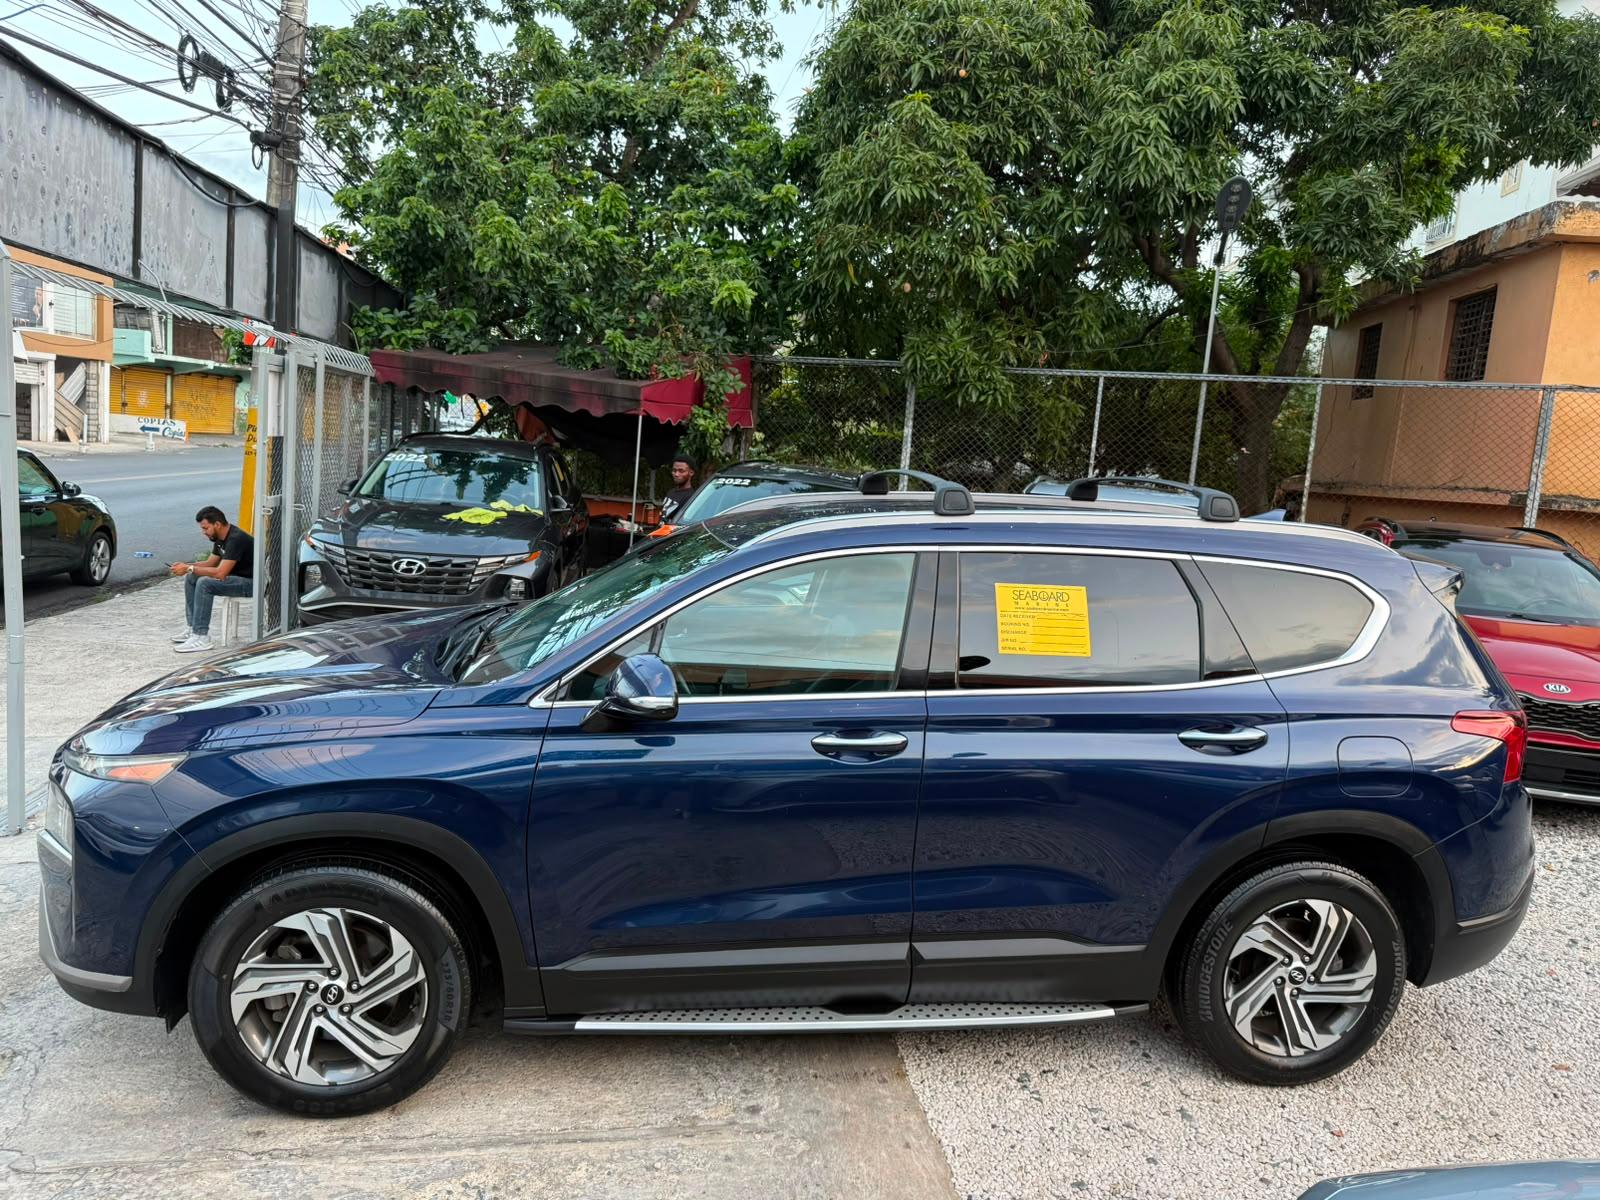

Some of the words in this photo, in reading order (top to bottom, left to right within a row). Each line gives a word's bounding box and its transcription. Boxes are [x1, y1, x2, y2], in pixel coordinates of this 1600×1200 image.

[137, 416, 176, 426] COPIAS
[384, 452, 428, 463] 2022
[1012, 590, 1070, 602] SEABOARD
[1547, 683, 1569, 693] KIA
[1199, 918, 1233, 1021] BRIDGESTONE
